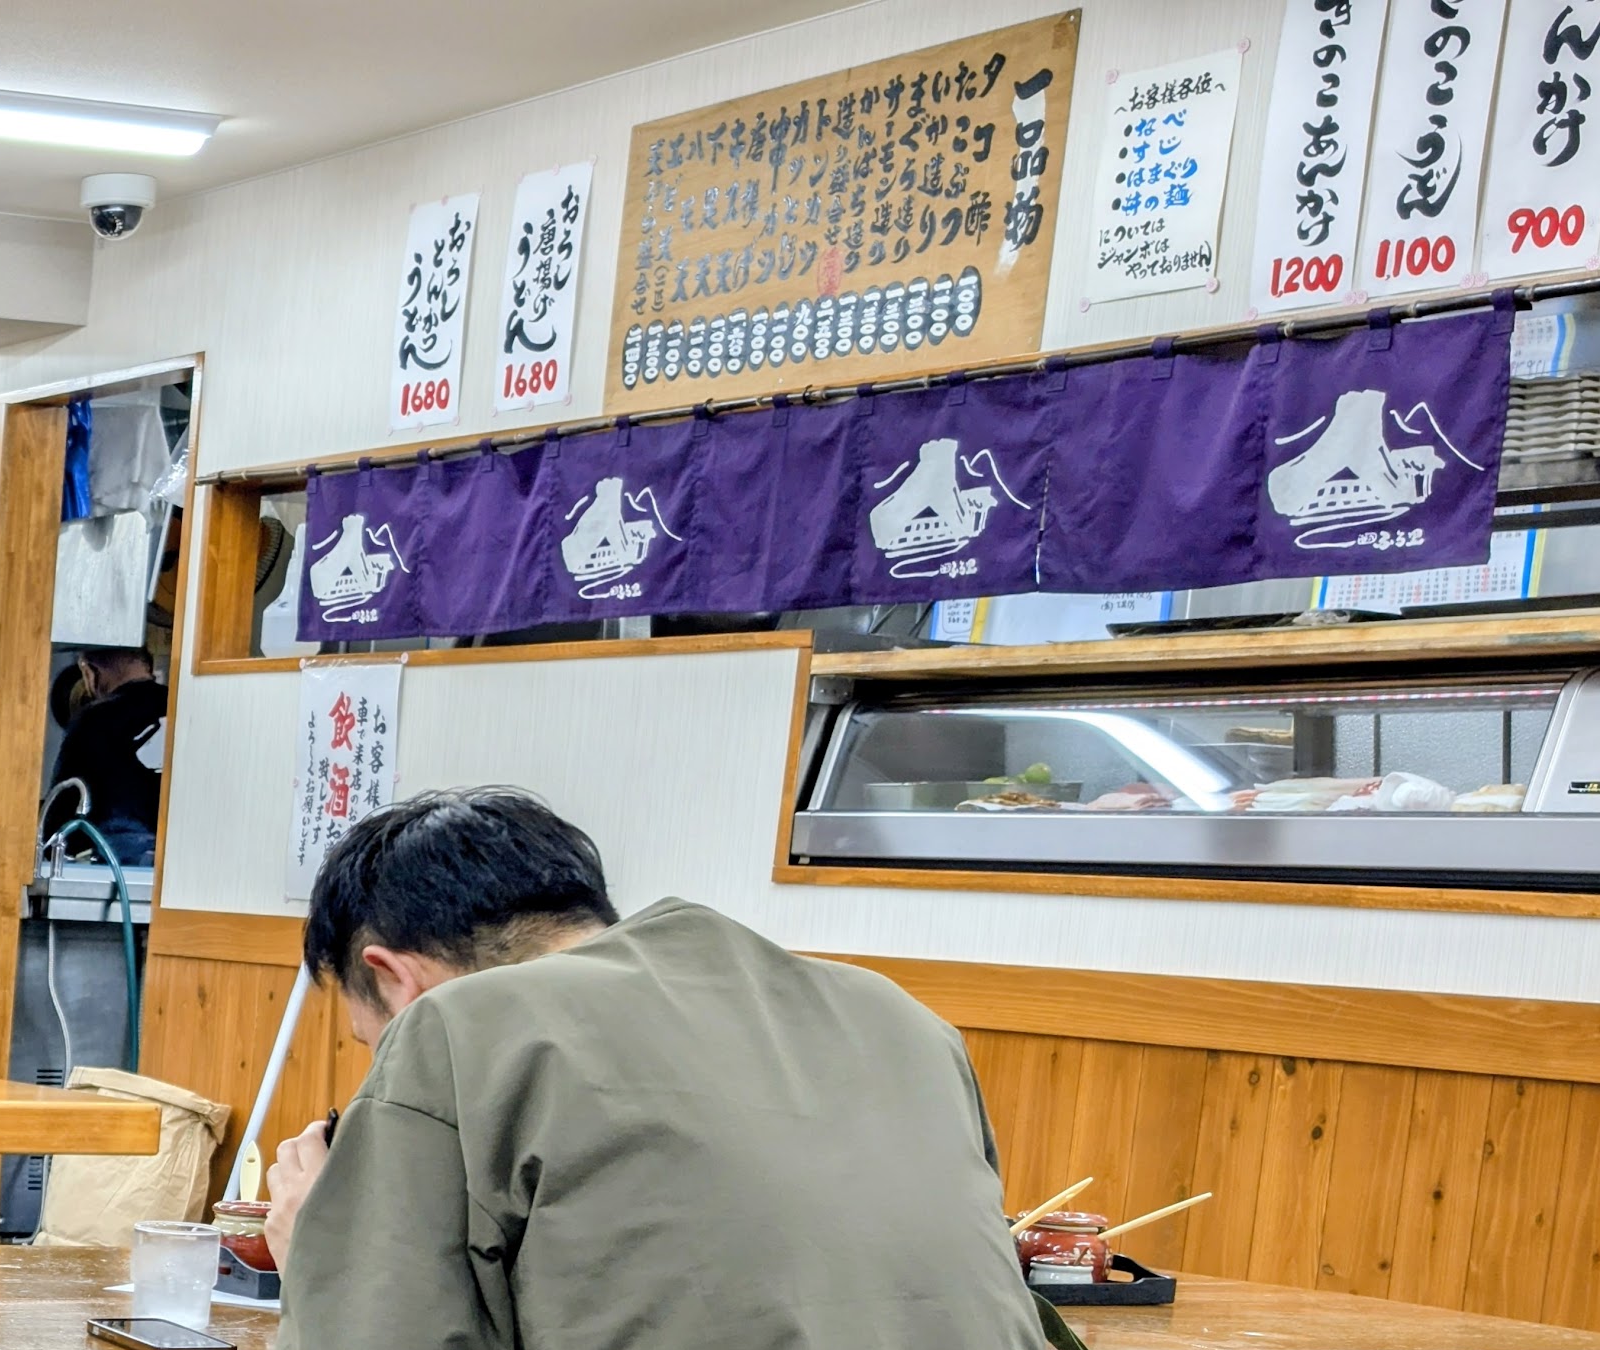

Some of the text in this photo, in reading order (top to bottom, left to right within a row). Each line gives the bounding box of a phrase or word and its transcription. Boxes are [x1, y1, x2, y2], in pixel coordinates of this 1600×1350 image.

[891, 71, 930, 264] まぐろ造り
[915, 70, 951, 254] いか造り
[964, 52, 1007, 247] タコ酢
[1003, 68, 1053, 252] 一品物
[1126, 157, 1198, 188] はまぐり
[1132, 136, 1182, 164] すじ
[1134, 109, 1188, 136] なべ
[440, 212, 471, 322] おろし
[528, 208, 555, 323] 唐揚げ
[554, 185, 580, 291] おろし
[1097, 238, 1170, 270] ジャンボは
[1099, 217, 1166, 248] については
[1507, 204, 1586, 253] 900
[399, 252, 452, 370] うどん
[419, 238, 446, 353] とんかつ
[504, 222, 558, 354] うどん
[297, 710, 317, 866] よろしくお願いします
[312, 757, 330, 845] 致します
[324, 690, 357, 818] 飲酒
[363, 704, 387, 810] お客様
